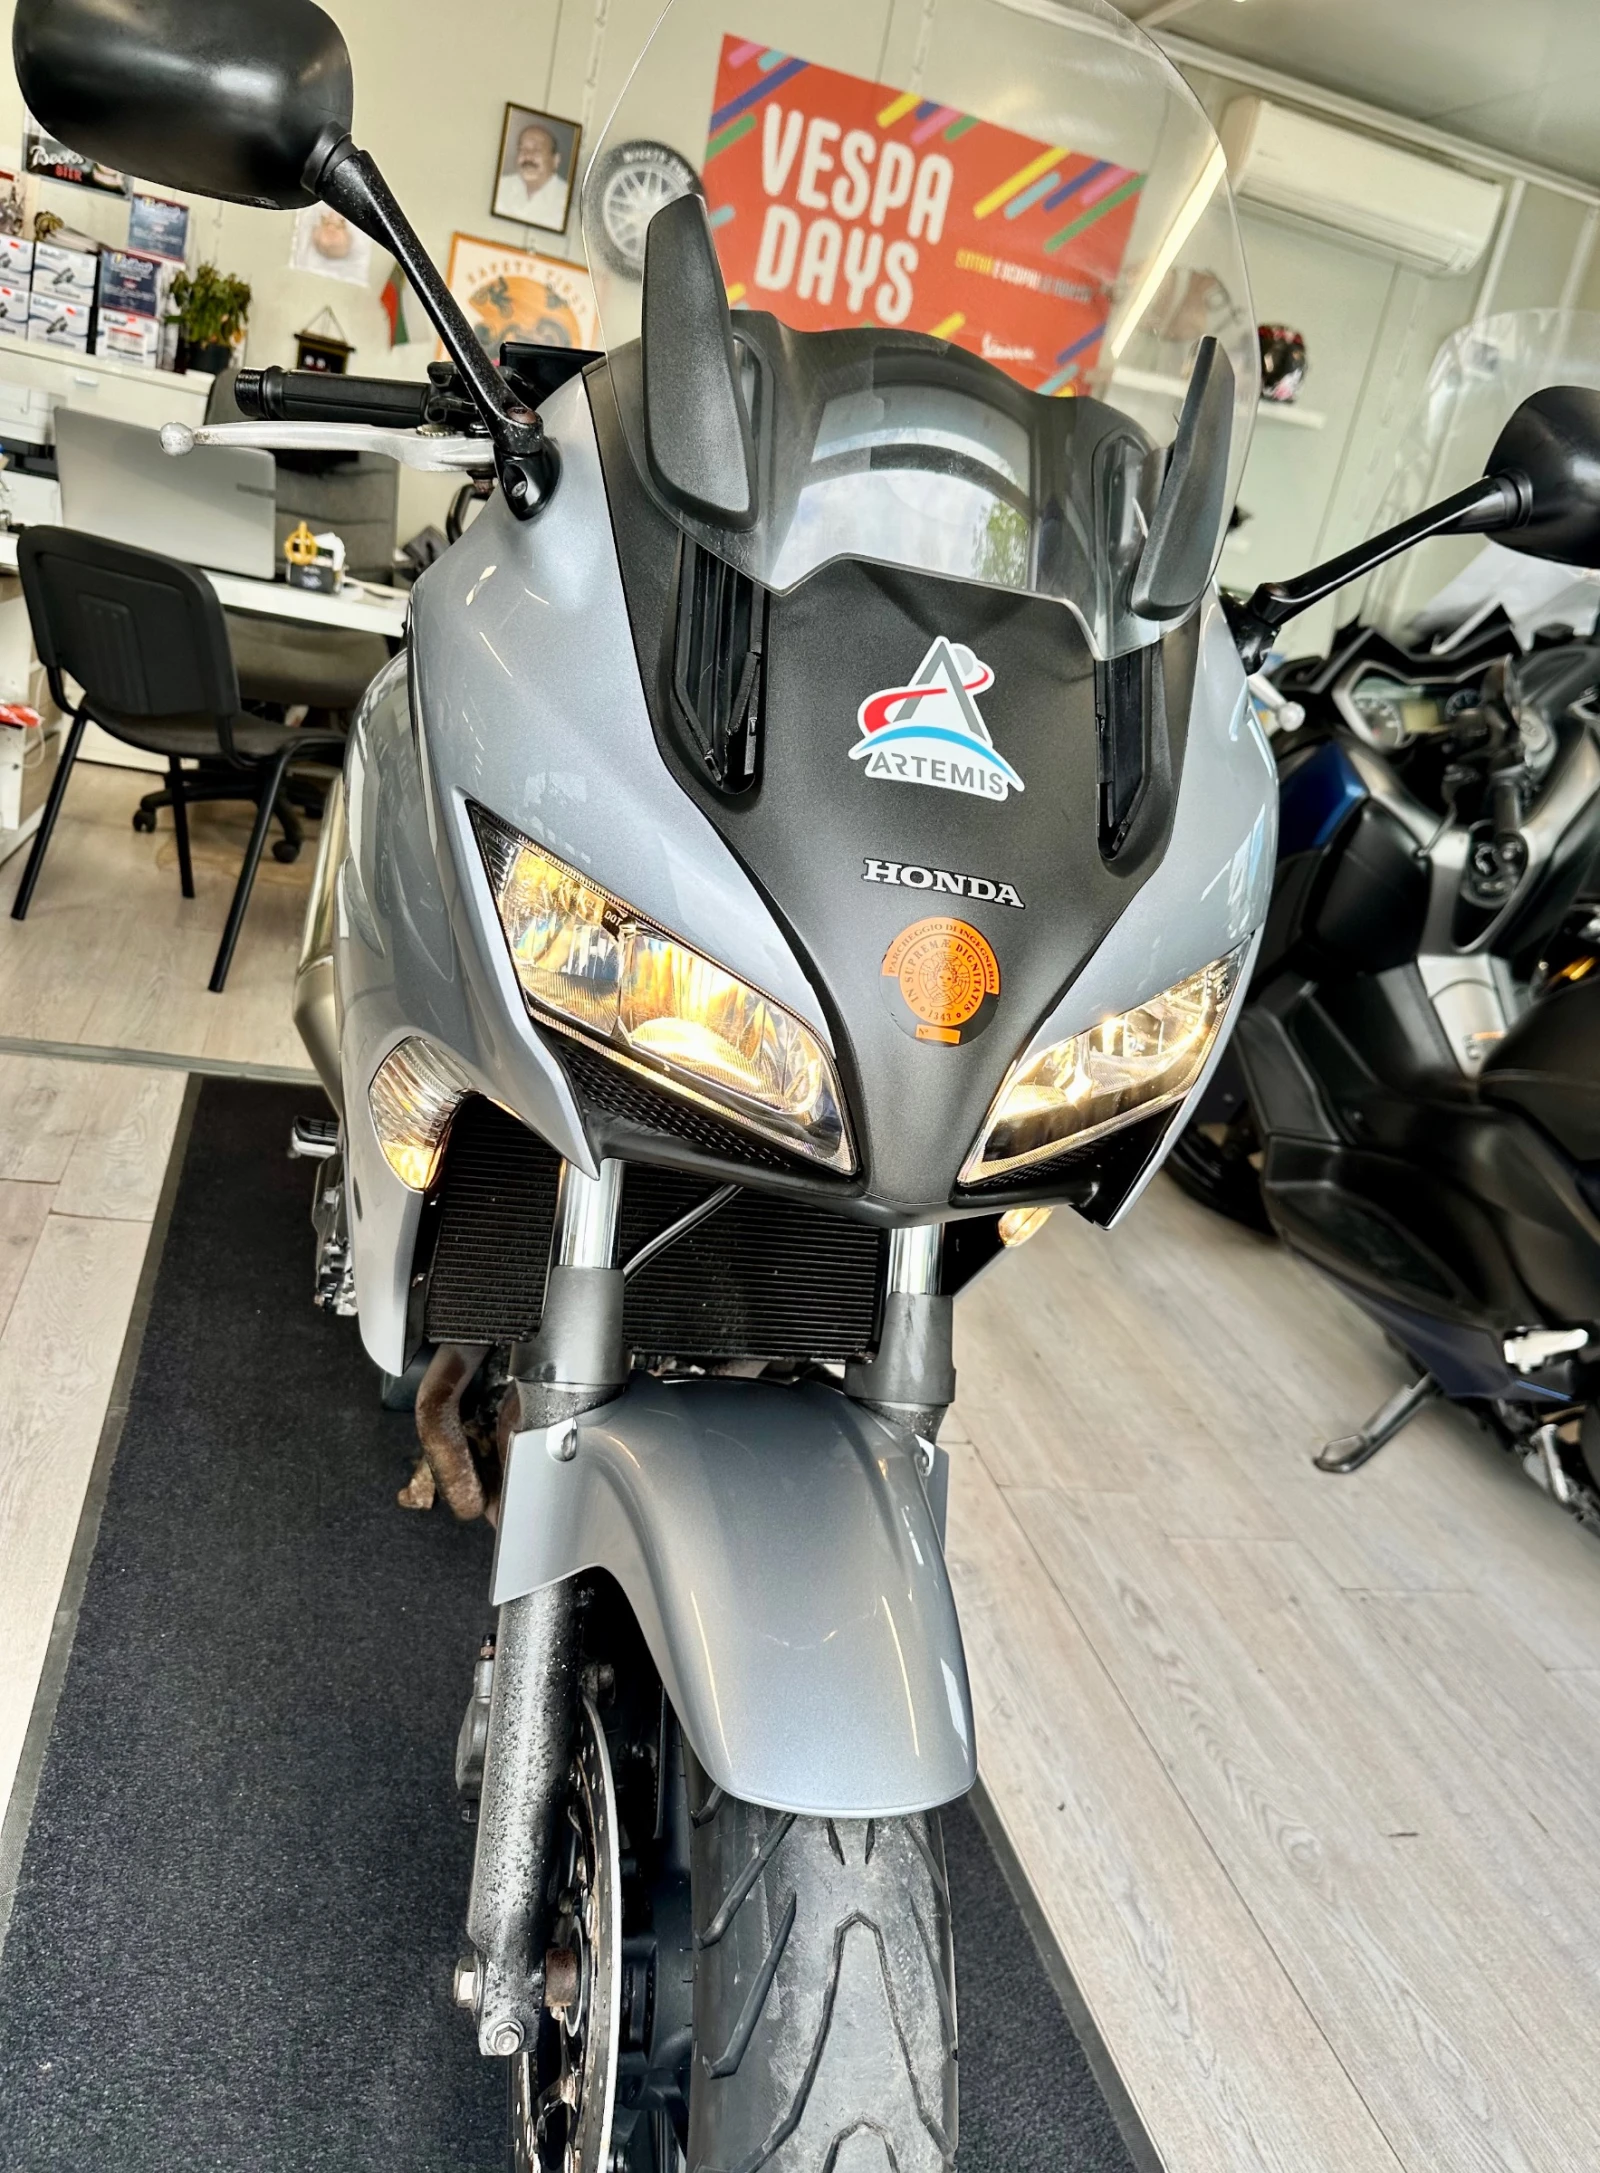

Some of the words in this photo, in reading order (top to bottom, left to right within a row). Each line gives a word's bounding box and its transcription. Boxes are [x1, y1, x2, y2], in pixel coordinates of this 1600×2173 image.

[762, 102, 954, 245] VESPA
[466, 260, 536, 285] SAFETY
[754, 204, 919, 325] DAYS
[871, 751, 1003, 795] ARTEMIS
[862, 859, 1025, 909] HONDA
[604, 910, 624, 926] DOT
[888, 924, 943, 974] PARCHEGGIO
[945, 924, 957, 932] DI
[960, 928, 995, 990] INGEGNERIA
[904, 988, 919, 1003] IN
[955, 943, 982, 1013] DIGNITATIS
[928, 1009, 952, 1022] 1343
